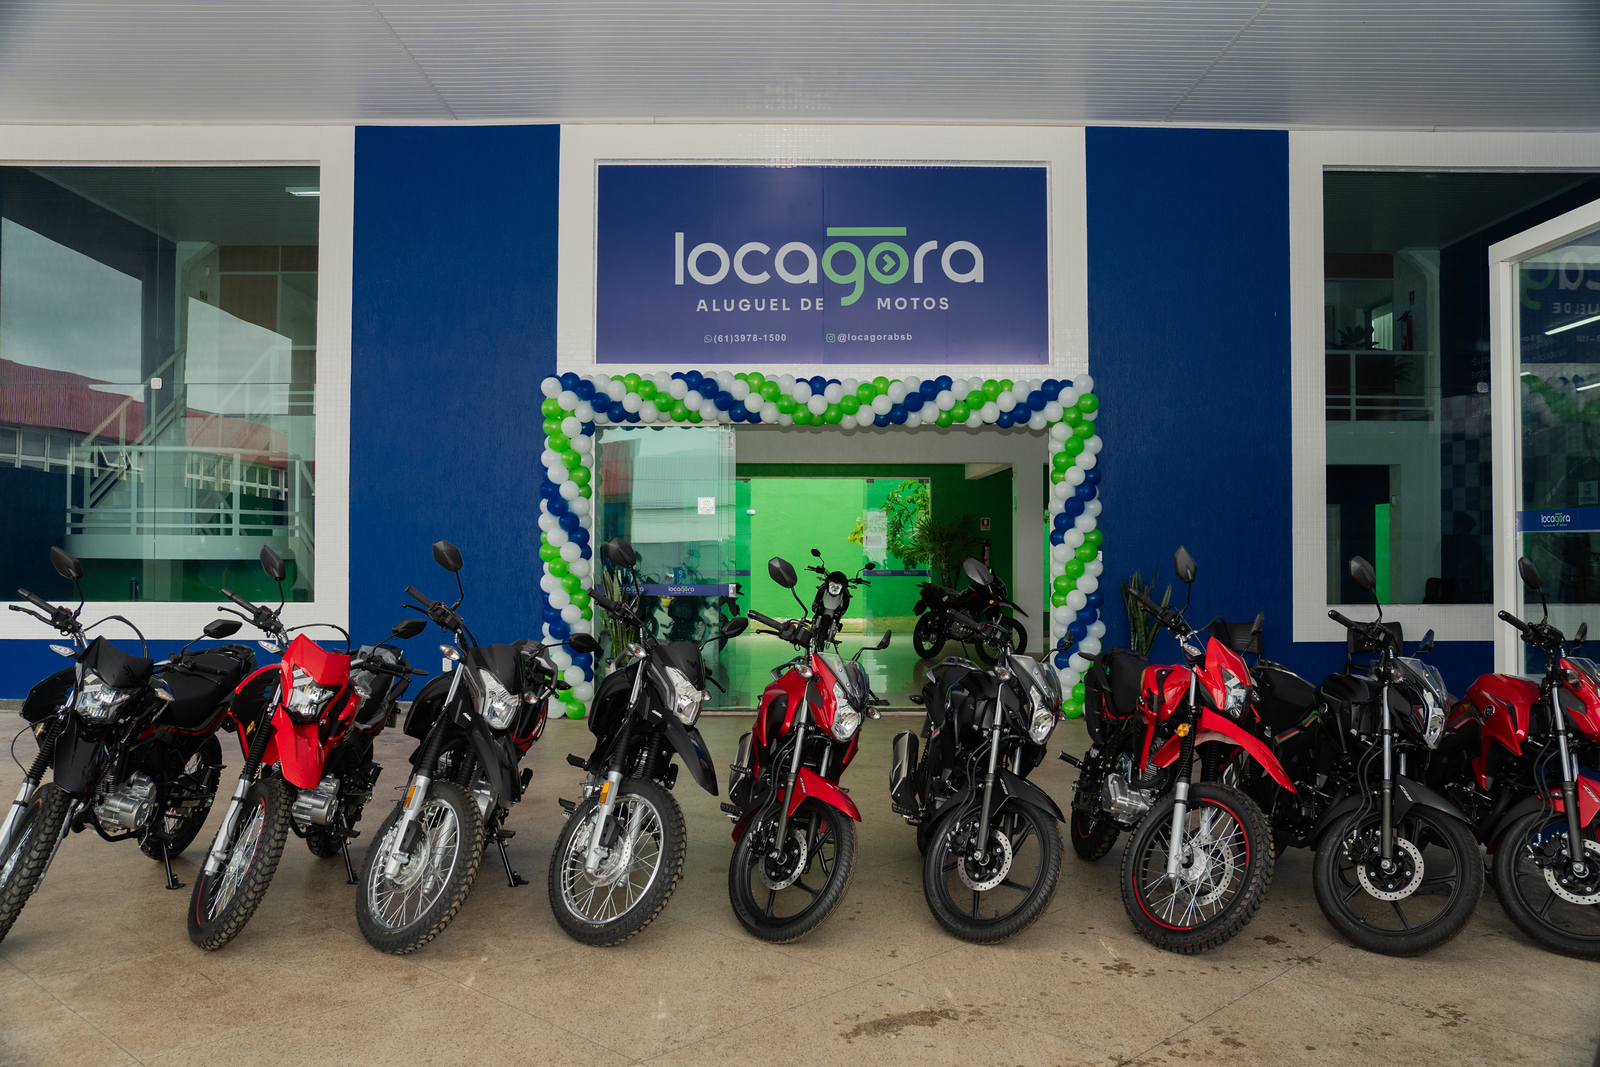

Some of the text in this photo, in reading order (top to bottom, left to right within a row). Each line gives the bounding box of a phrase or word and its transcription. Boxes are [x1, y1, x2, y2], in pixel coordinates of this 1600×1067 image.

[675, 227, 984, 306] locagora
[696, 297, 949, 312] ALUGUEL DE MOTOS
[713, 334, 787, 344] (61)3978-1500
[837, 333, 913, 343] @locagorabsb
[1541, 513, 1570, 526] locagora
[668, 586, 695, 594] locagora
